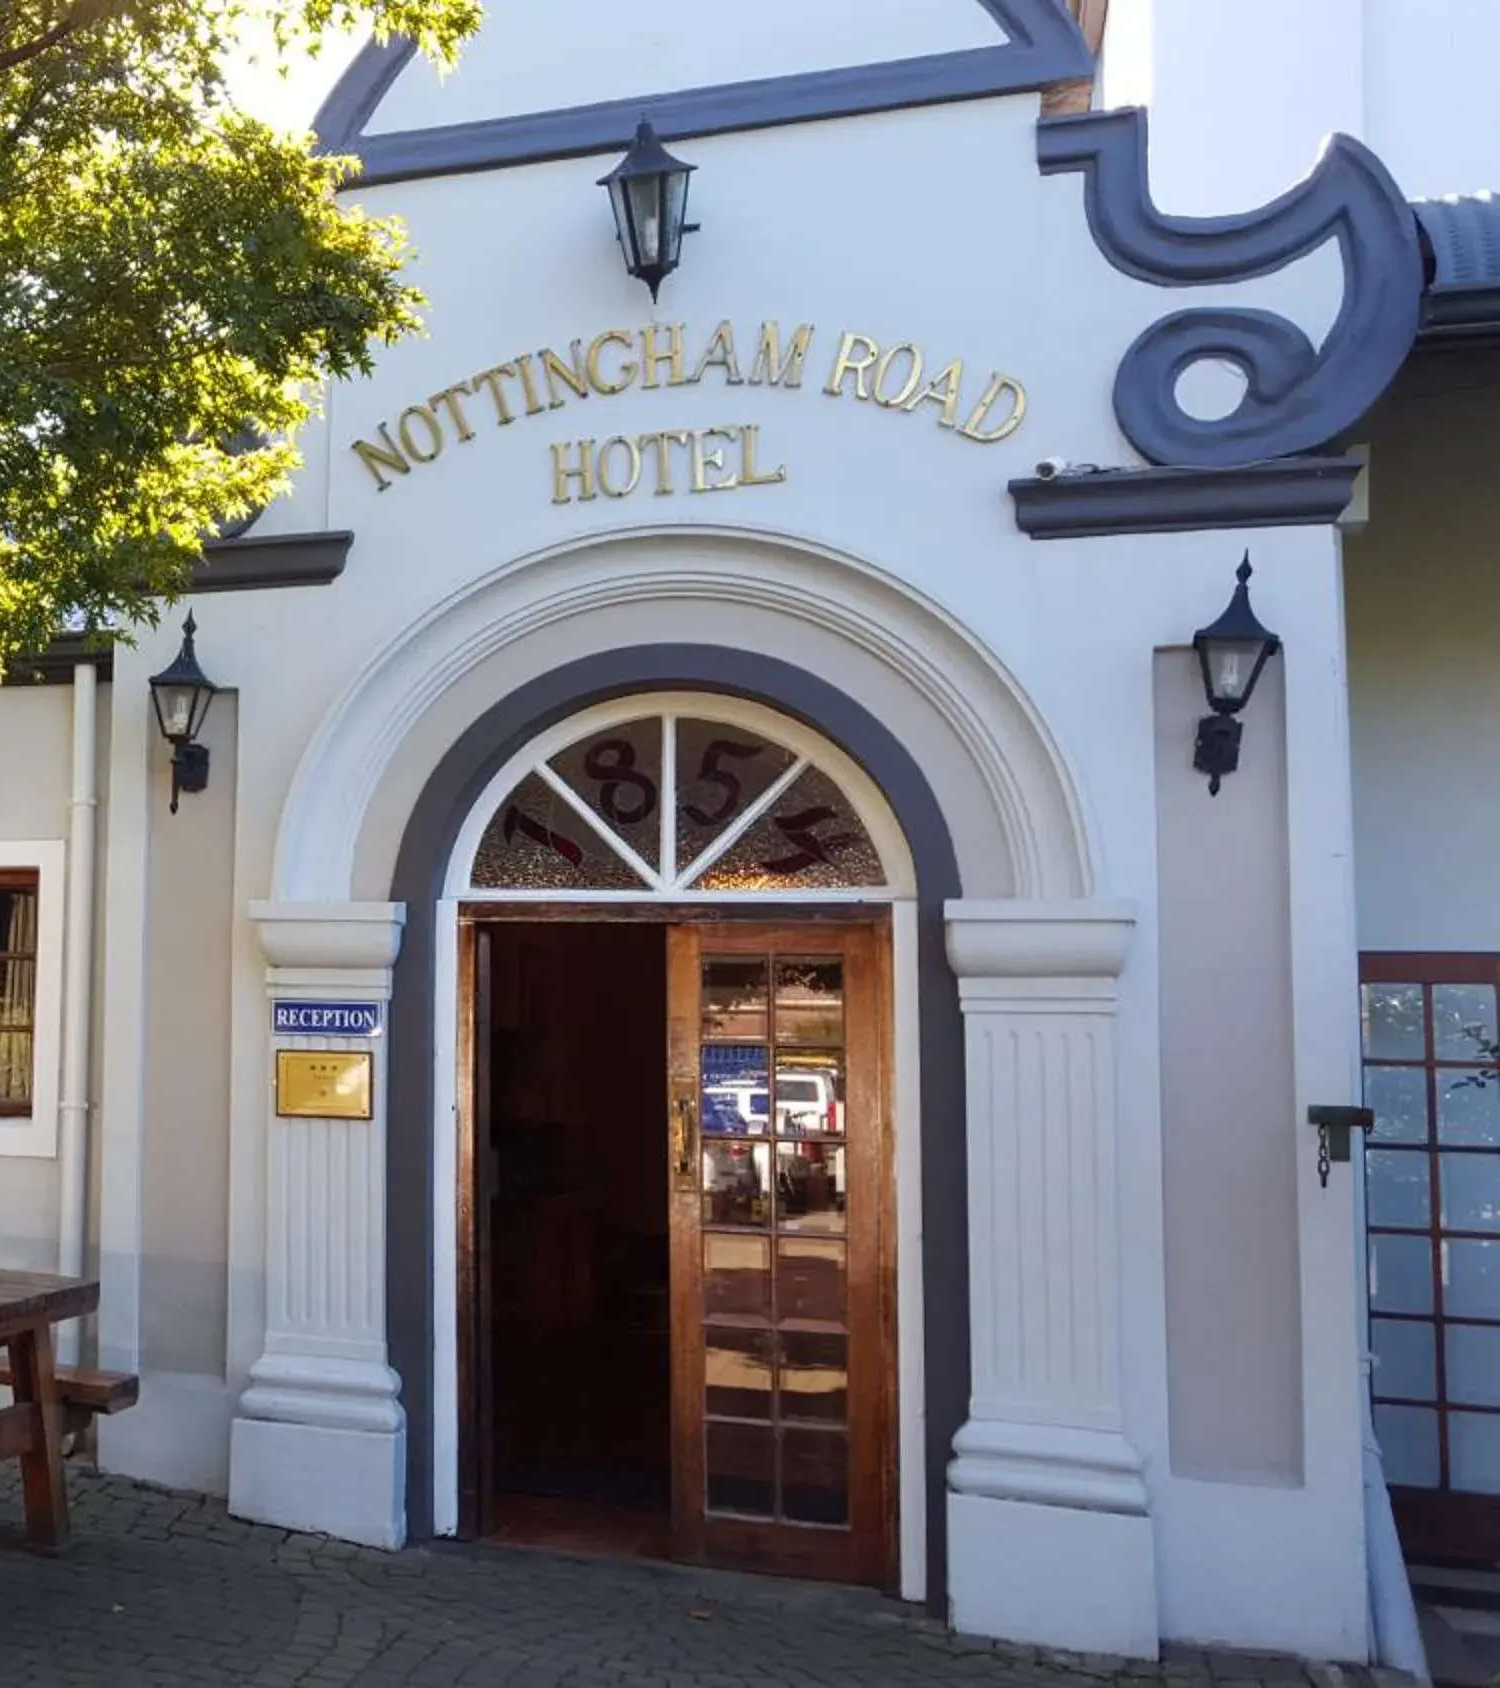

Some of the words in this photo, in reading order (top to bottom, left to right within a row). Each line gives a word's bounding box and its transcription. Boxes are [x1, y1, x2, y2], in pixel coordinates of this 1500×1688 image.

[351, 320, 816, 491] NOTTINGHAM
[822, 330, 1028, 443] ROAD
[550, 424, 787, 504] HOTEL
[276, 1008, 376, 1028] RECEPTION
